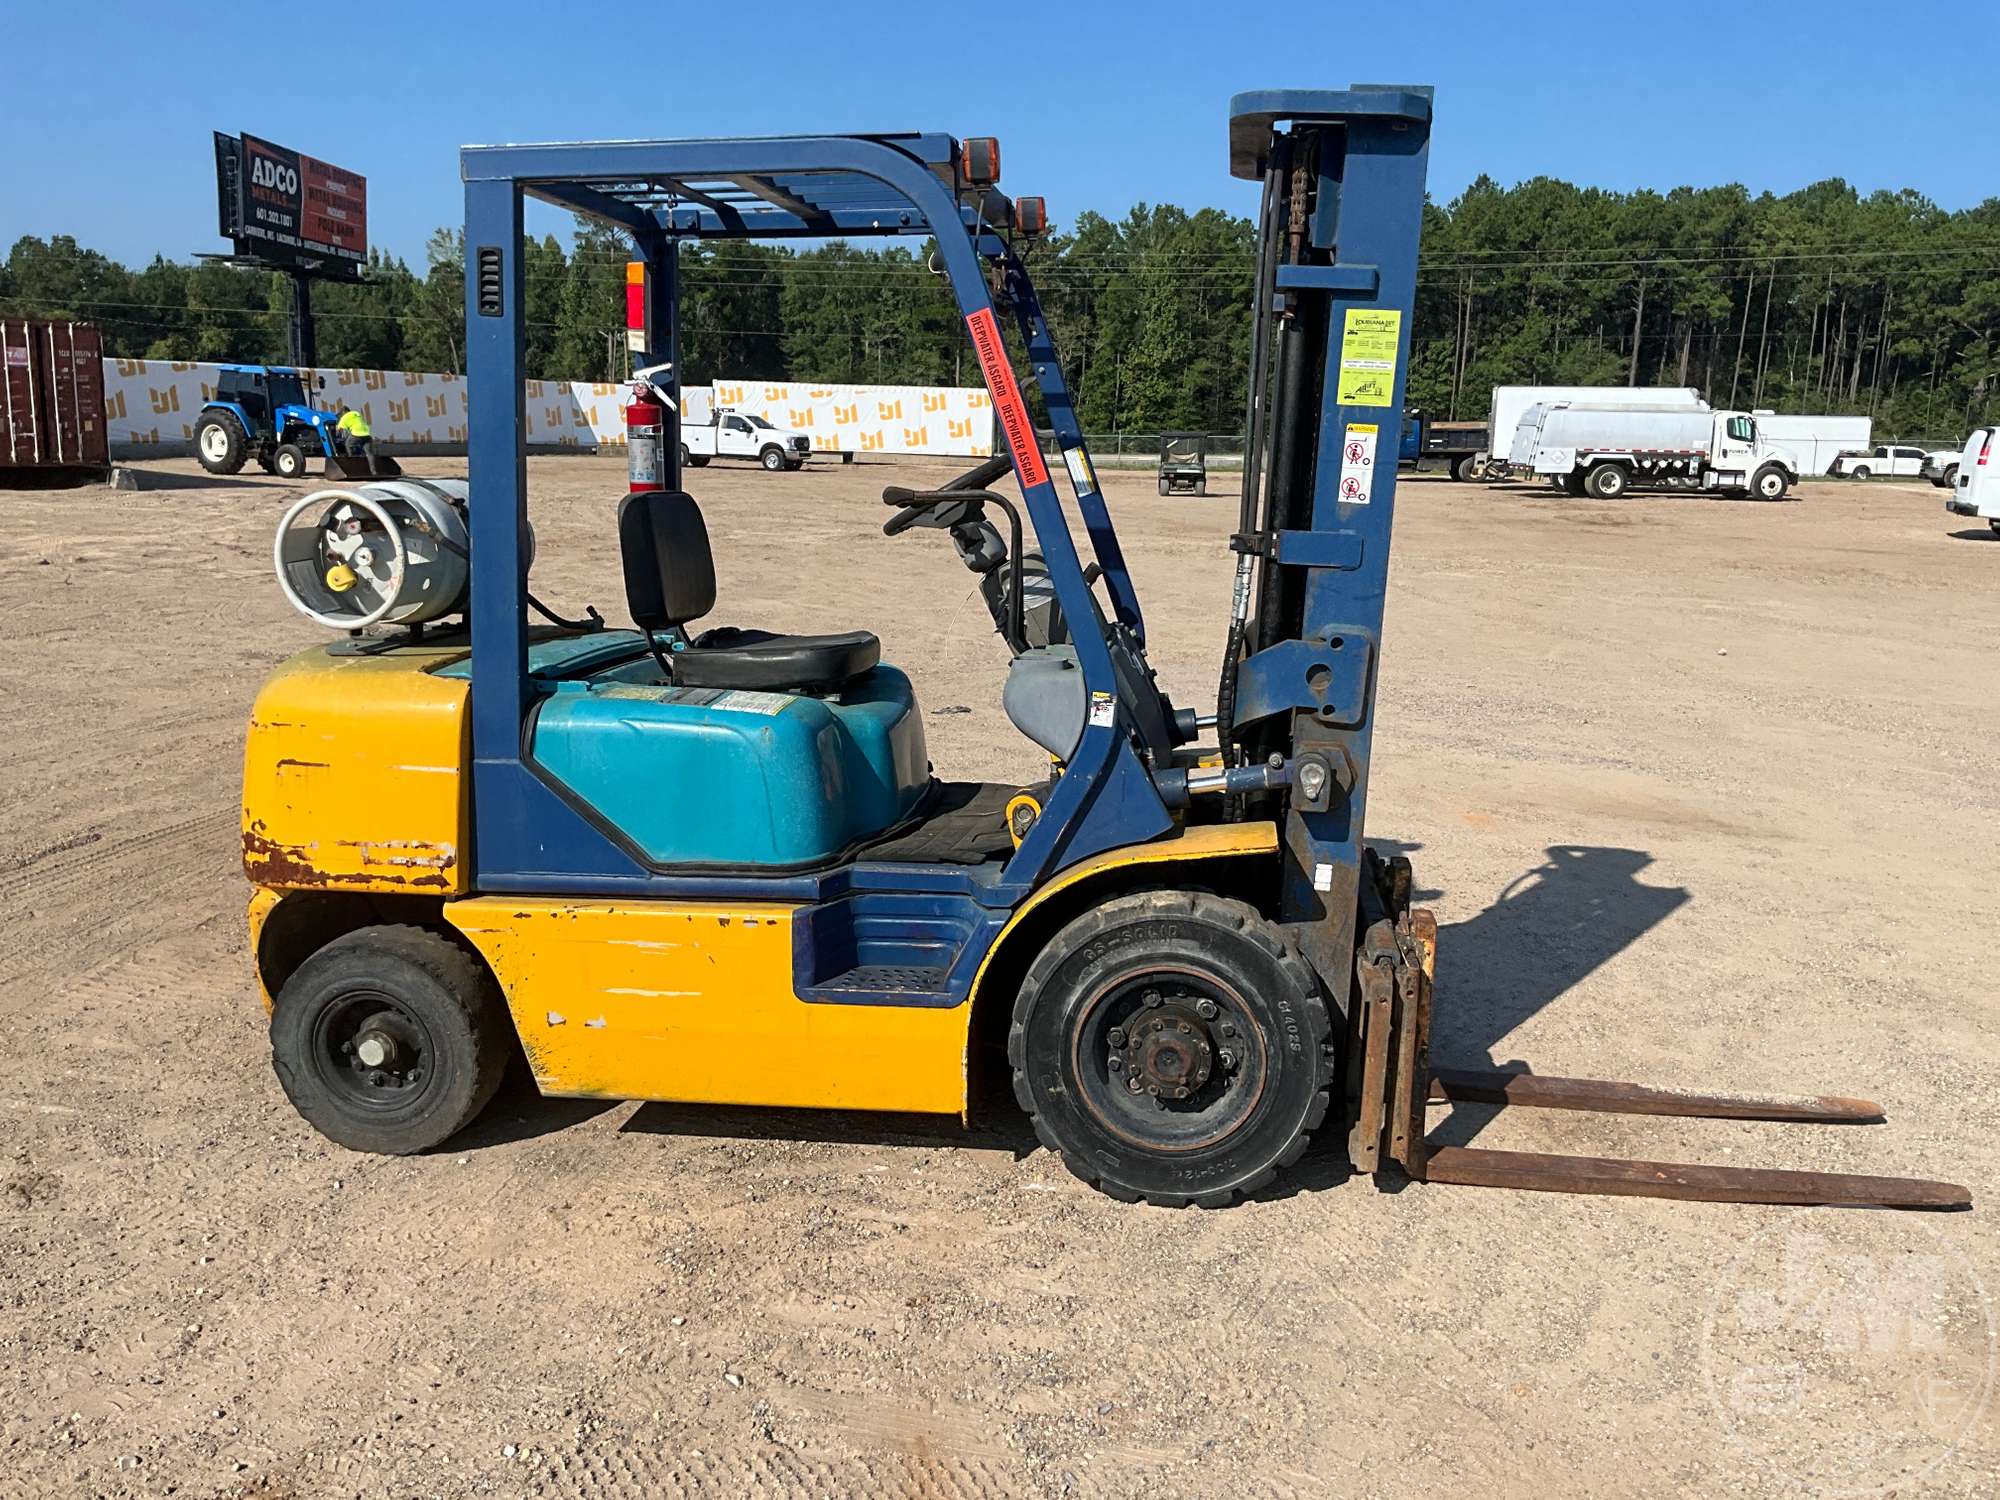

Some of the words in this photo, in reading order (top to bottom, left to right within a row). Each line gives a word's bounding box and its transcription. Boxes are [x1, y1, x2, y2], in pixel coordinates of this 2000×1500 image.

[251, 157, 298, 195] ADCO
[970, 315, 995, 363] DEEPWATER
[988, 364, 1008, 398] ASGARD
[1002, 403, 1025, 451] DEEPWATER
[1018, 451, 1037, 484] ASGARD
